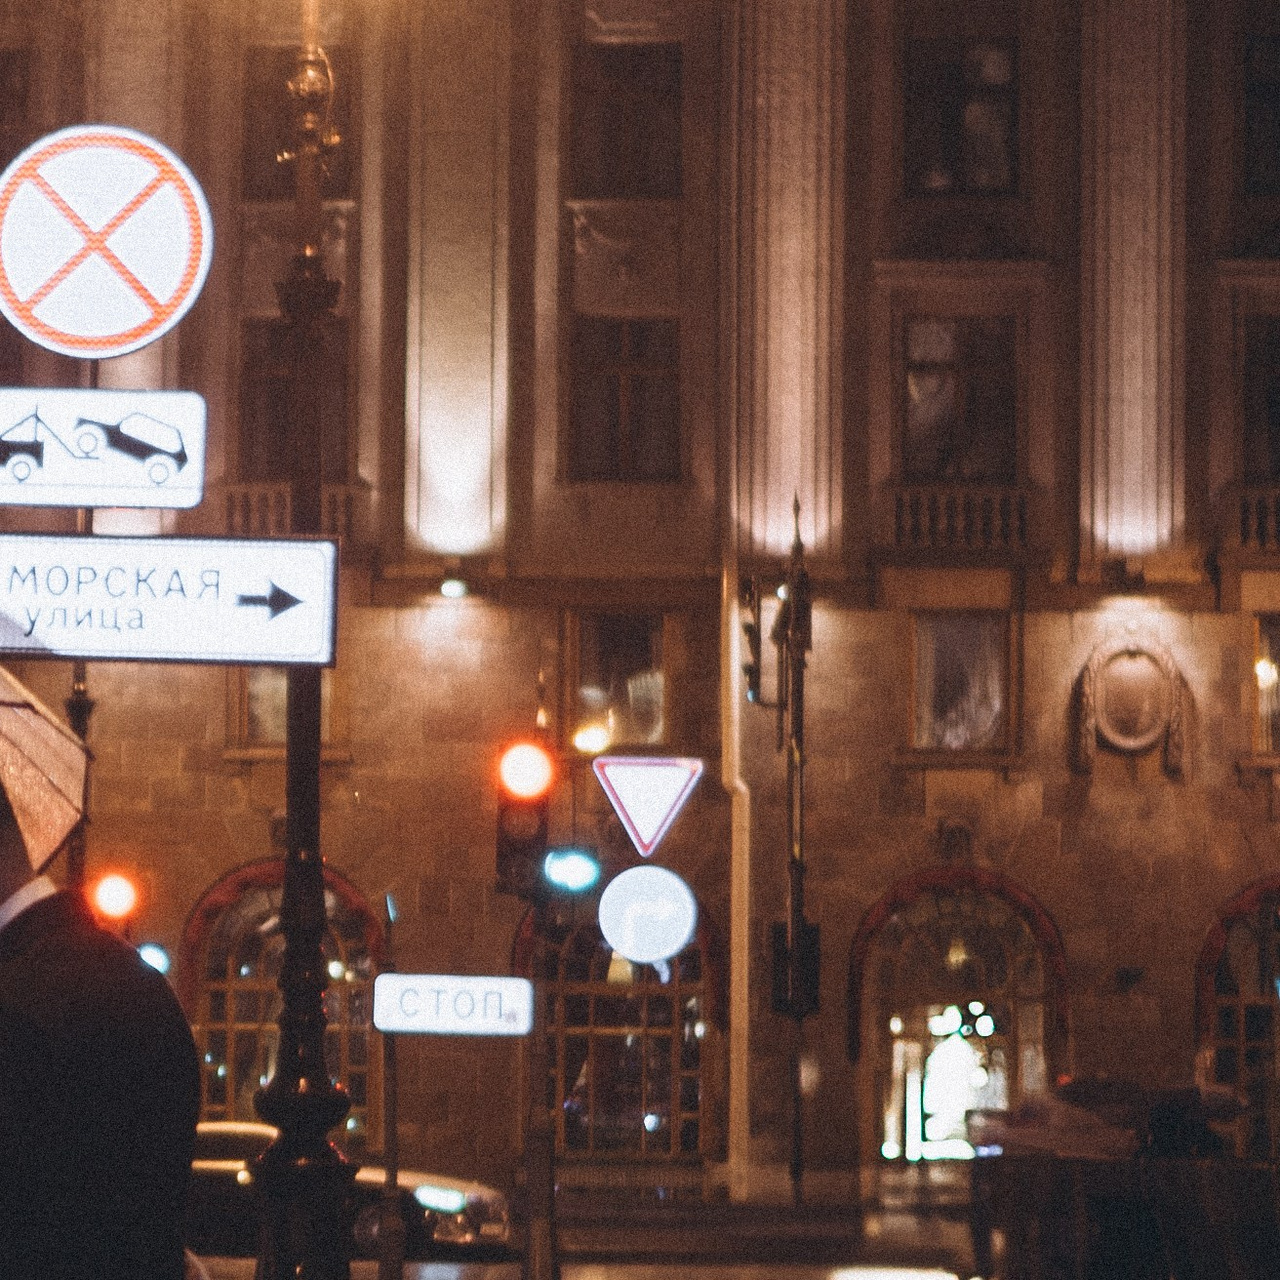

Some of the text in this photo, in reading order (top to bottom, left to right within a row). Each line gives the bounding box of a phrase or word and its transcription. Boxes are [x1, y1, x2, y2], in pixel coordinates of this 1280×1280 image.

[8, 564, 221, 600] МОРСКАЯ
[22, 604, 145, 637] улица
[399, 987, 503, 1020] СТОП
